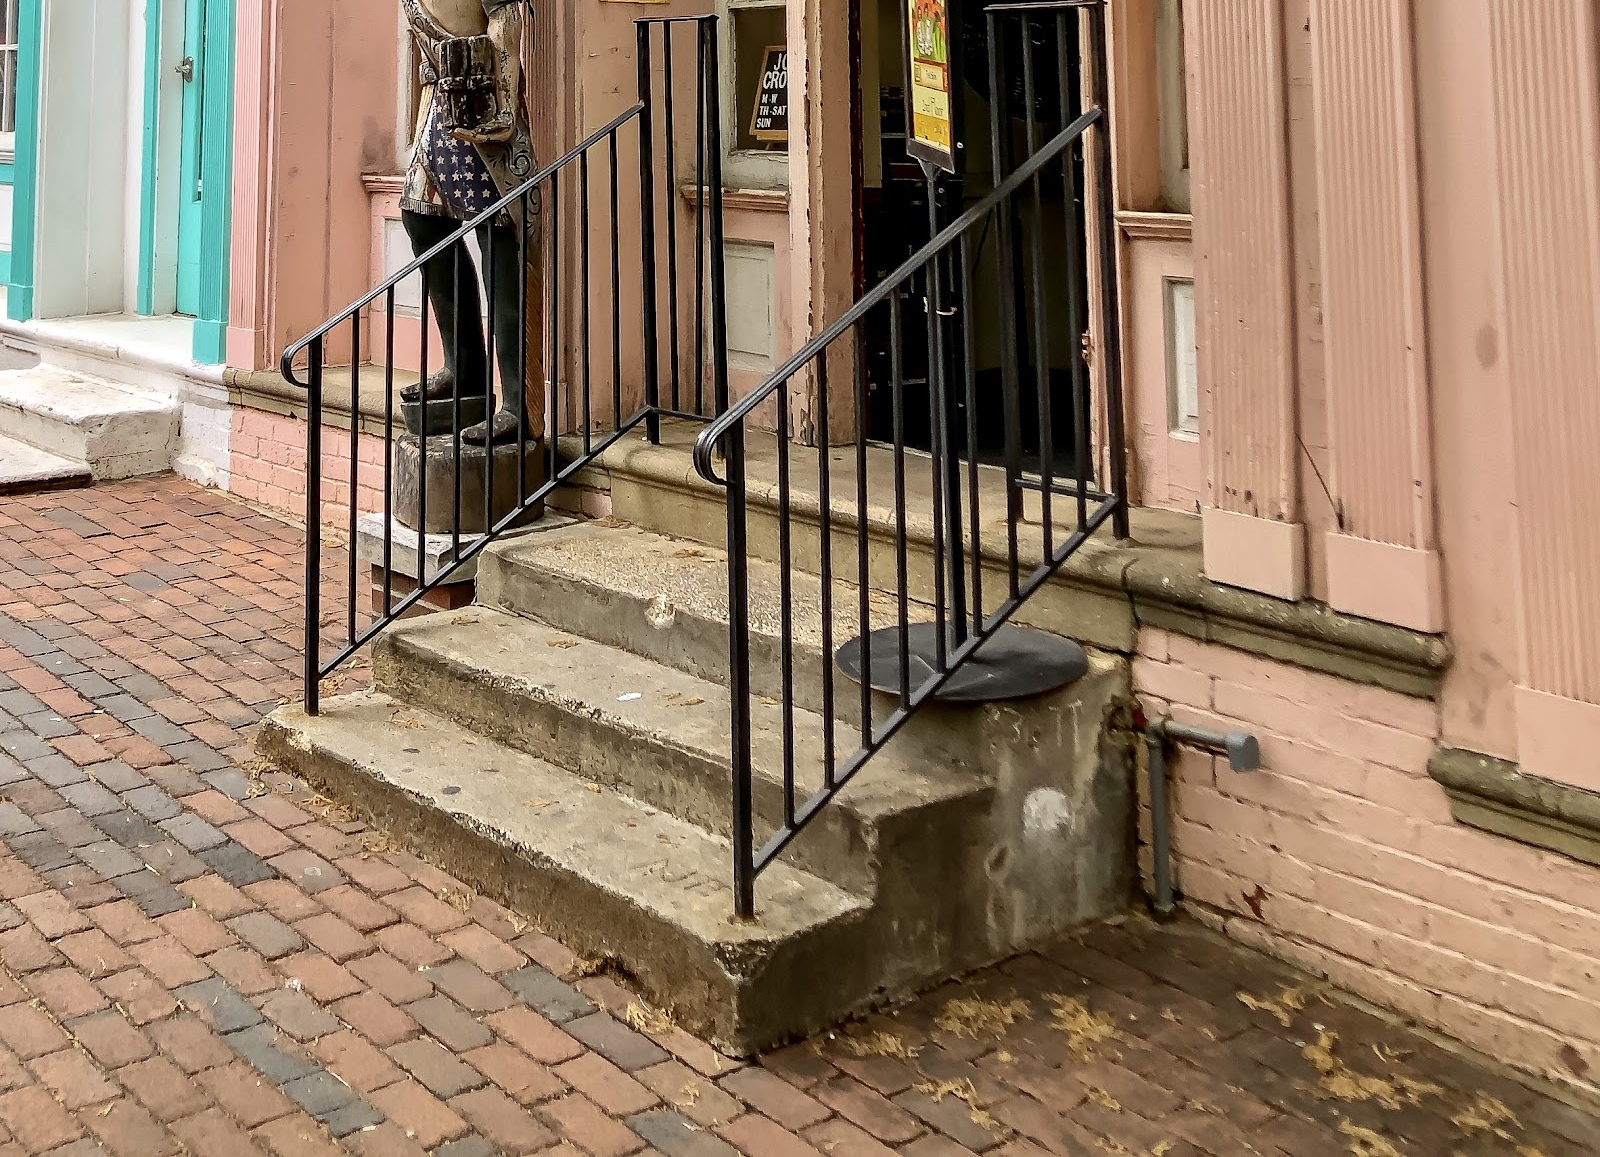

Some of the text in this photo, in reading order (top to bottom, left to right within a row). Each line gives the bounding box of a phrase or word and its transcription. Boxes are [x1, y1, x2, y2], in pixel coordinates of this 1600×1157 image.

[773, 52, 788, 71] JO
[762, 70, 788, 90] CRO
[756, 117, 772, 129] SUN
